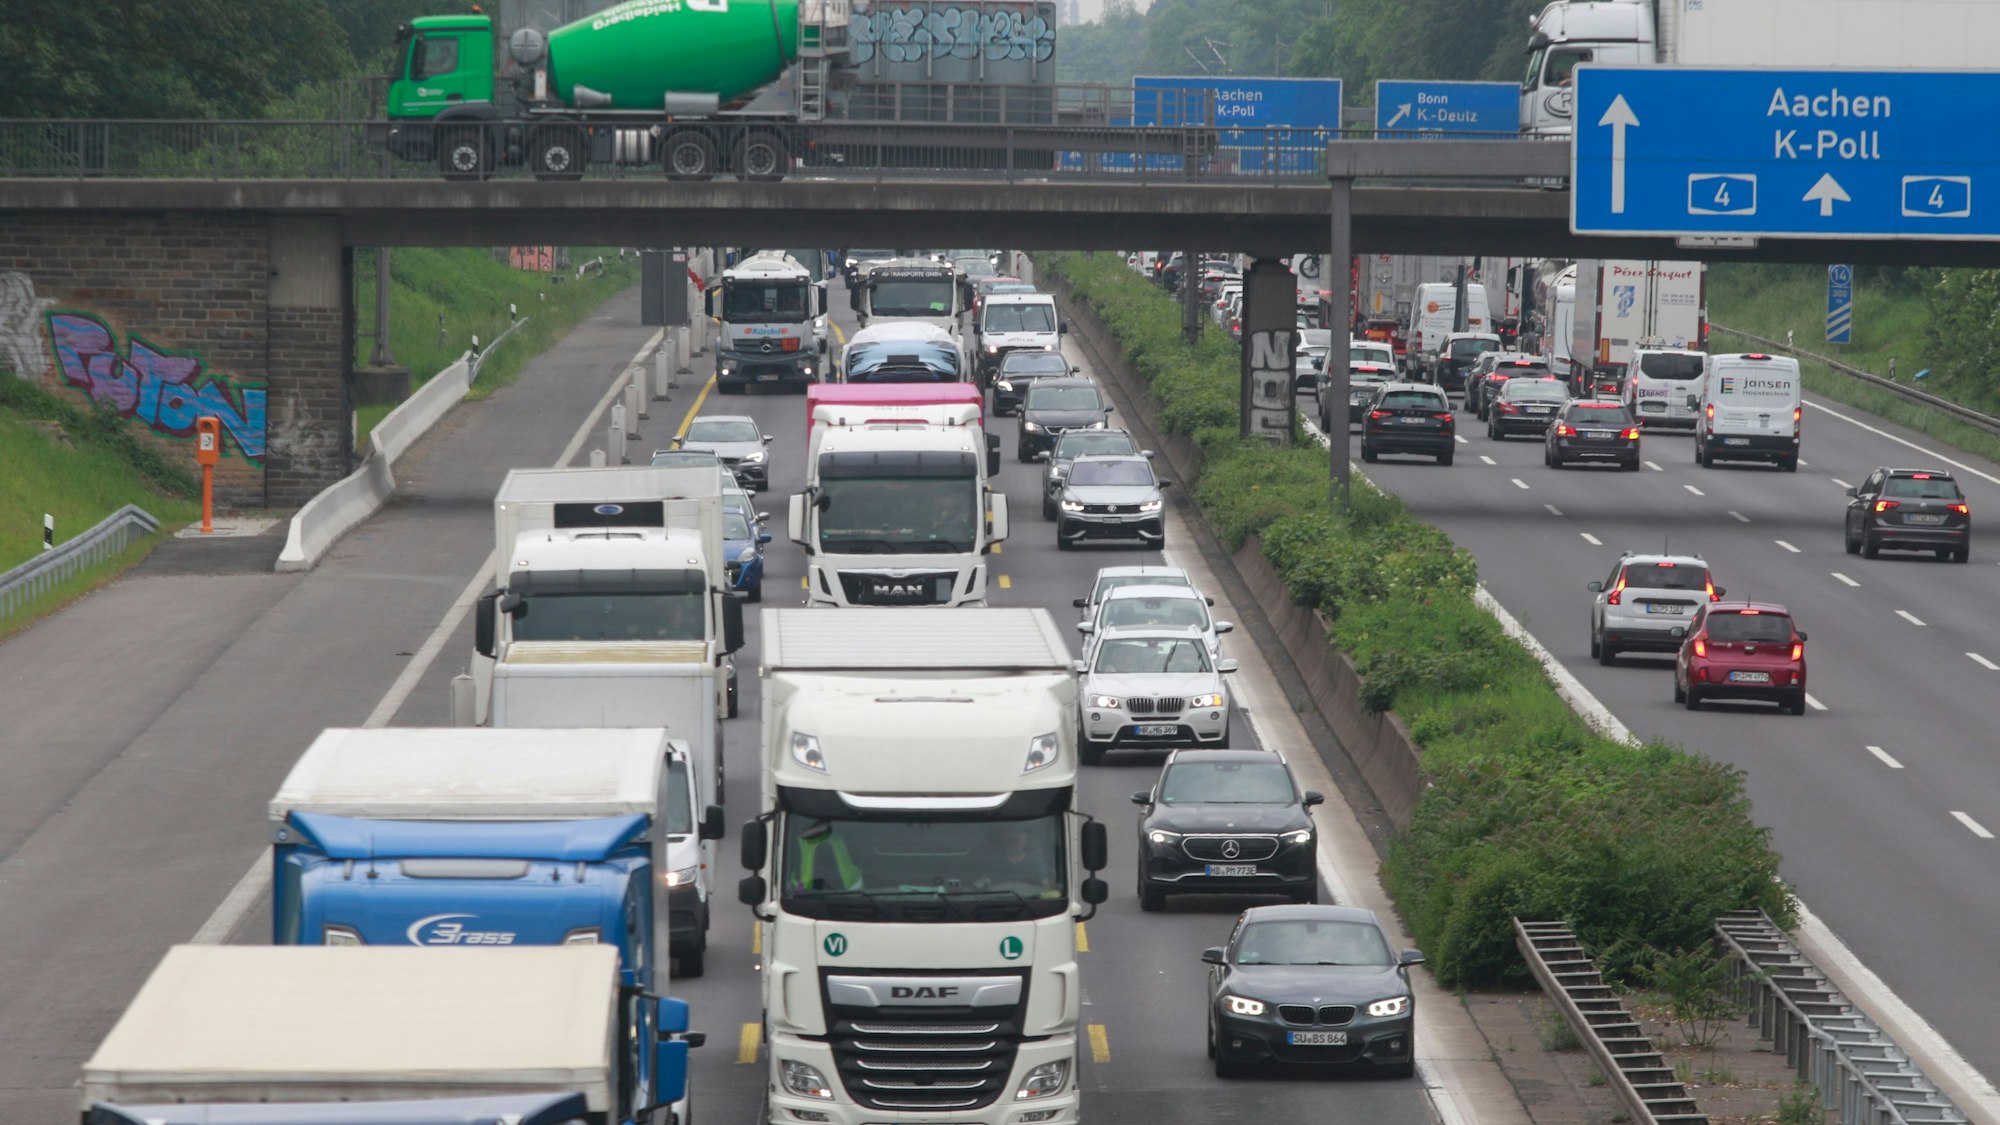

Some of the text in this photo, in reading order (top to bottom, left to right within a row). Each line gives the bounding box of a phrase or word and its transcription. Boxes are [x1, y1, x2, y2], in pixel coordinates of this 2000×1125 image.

[592, 2, 682, 31] Heidelberg
[1214, 88, 1263, 101] Aachen
[1418, 93, 1449, 104] Bonn
[1767, 87, 1891, 117] Aachen
[1218, 105, 1255, 116] K-Poll
[1417, 109, 1478, 123] K.-Deutz
[1774, 129, 1881, 159] K-Poll
[1713, 182, 1944, 209] 4 4
[1835, 269, 1846, 281] 14
[873, 584, 923, 596] MAN
[1004, 938, 1019, 958] L
[890, 986, 959, 999] DAF
[1294, 1033, 1345, 1044] SU BS 864
